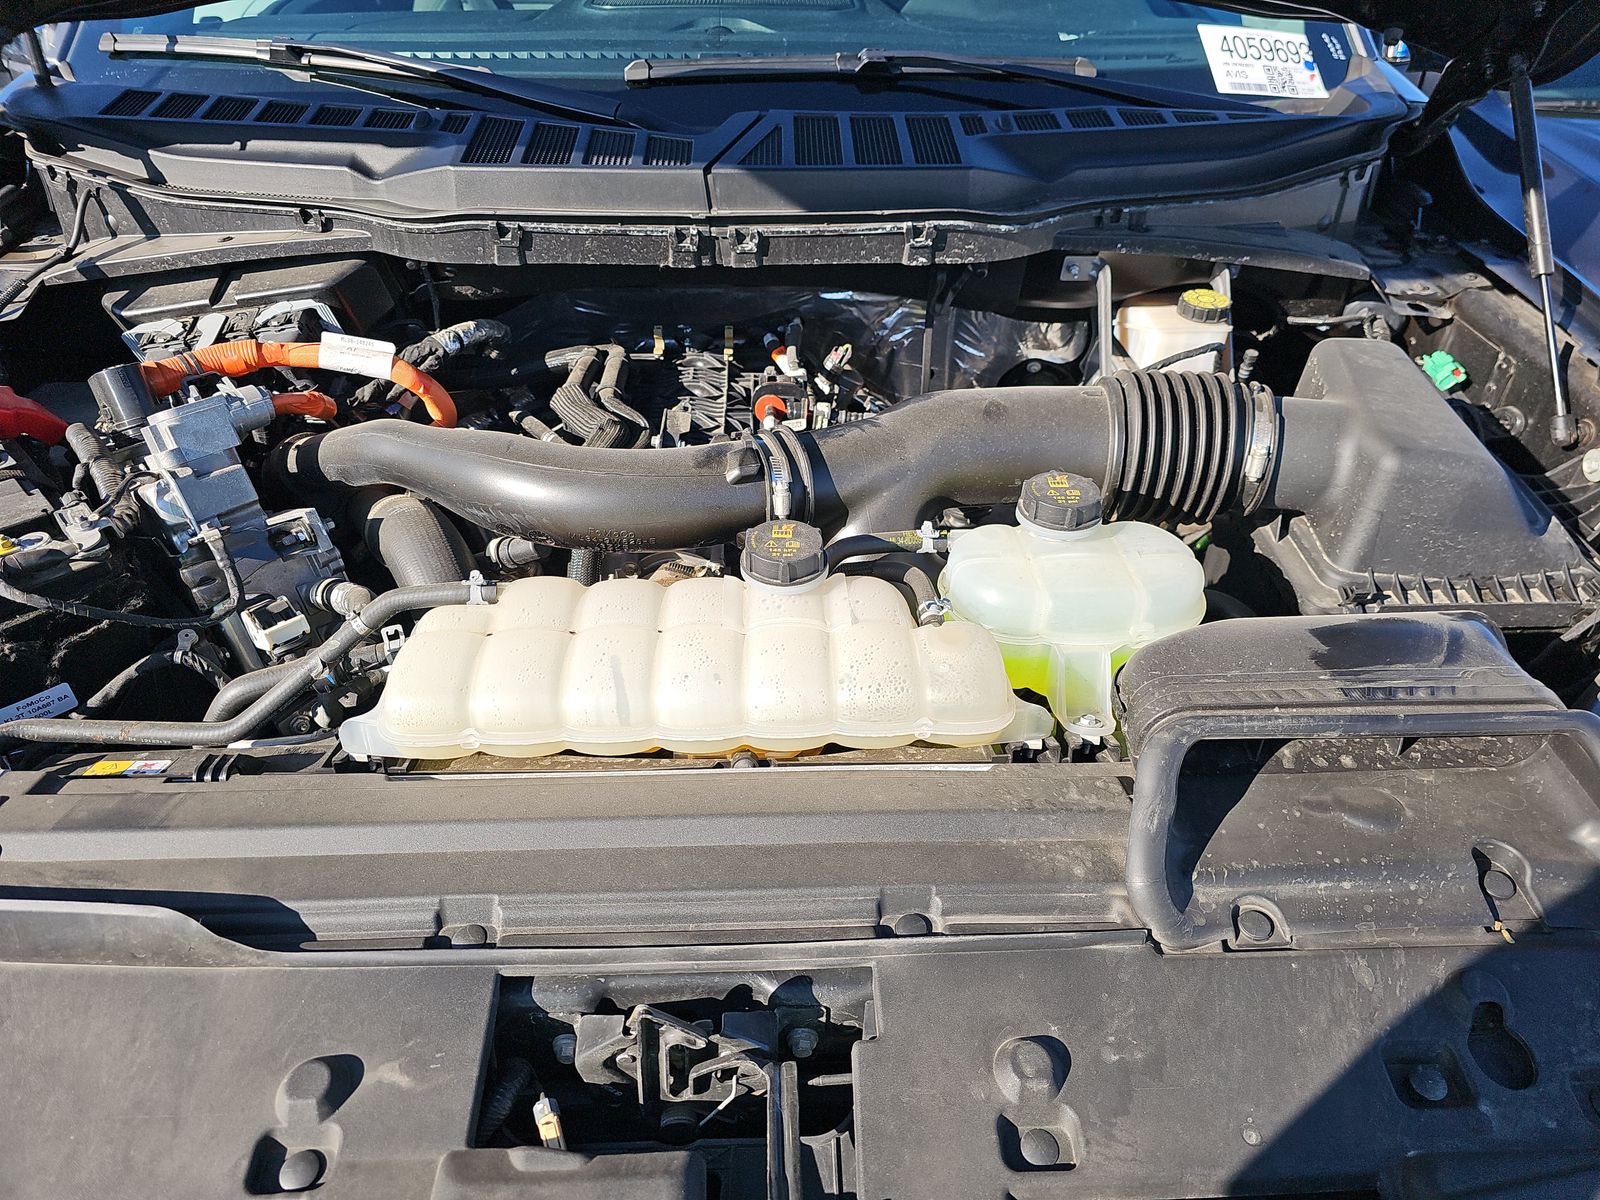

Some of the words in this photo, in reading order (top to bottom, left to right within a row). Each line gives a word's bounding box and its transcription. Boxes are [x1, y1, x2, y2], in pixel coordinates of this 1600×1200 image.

[1225, 69, 1249, 79] AVIS
[588, 526, 635, 539] FoMoCo
[15, 694, 51, 712] FoMoCo
[56, 694, 70, 703] BA
